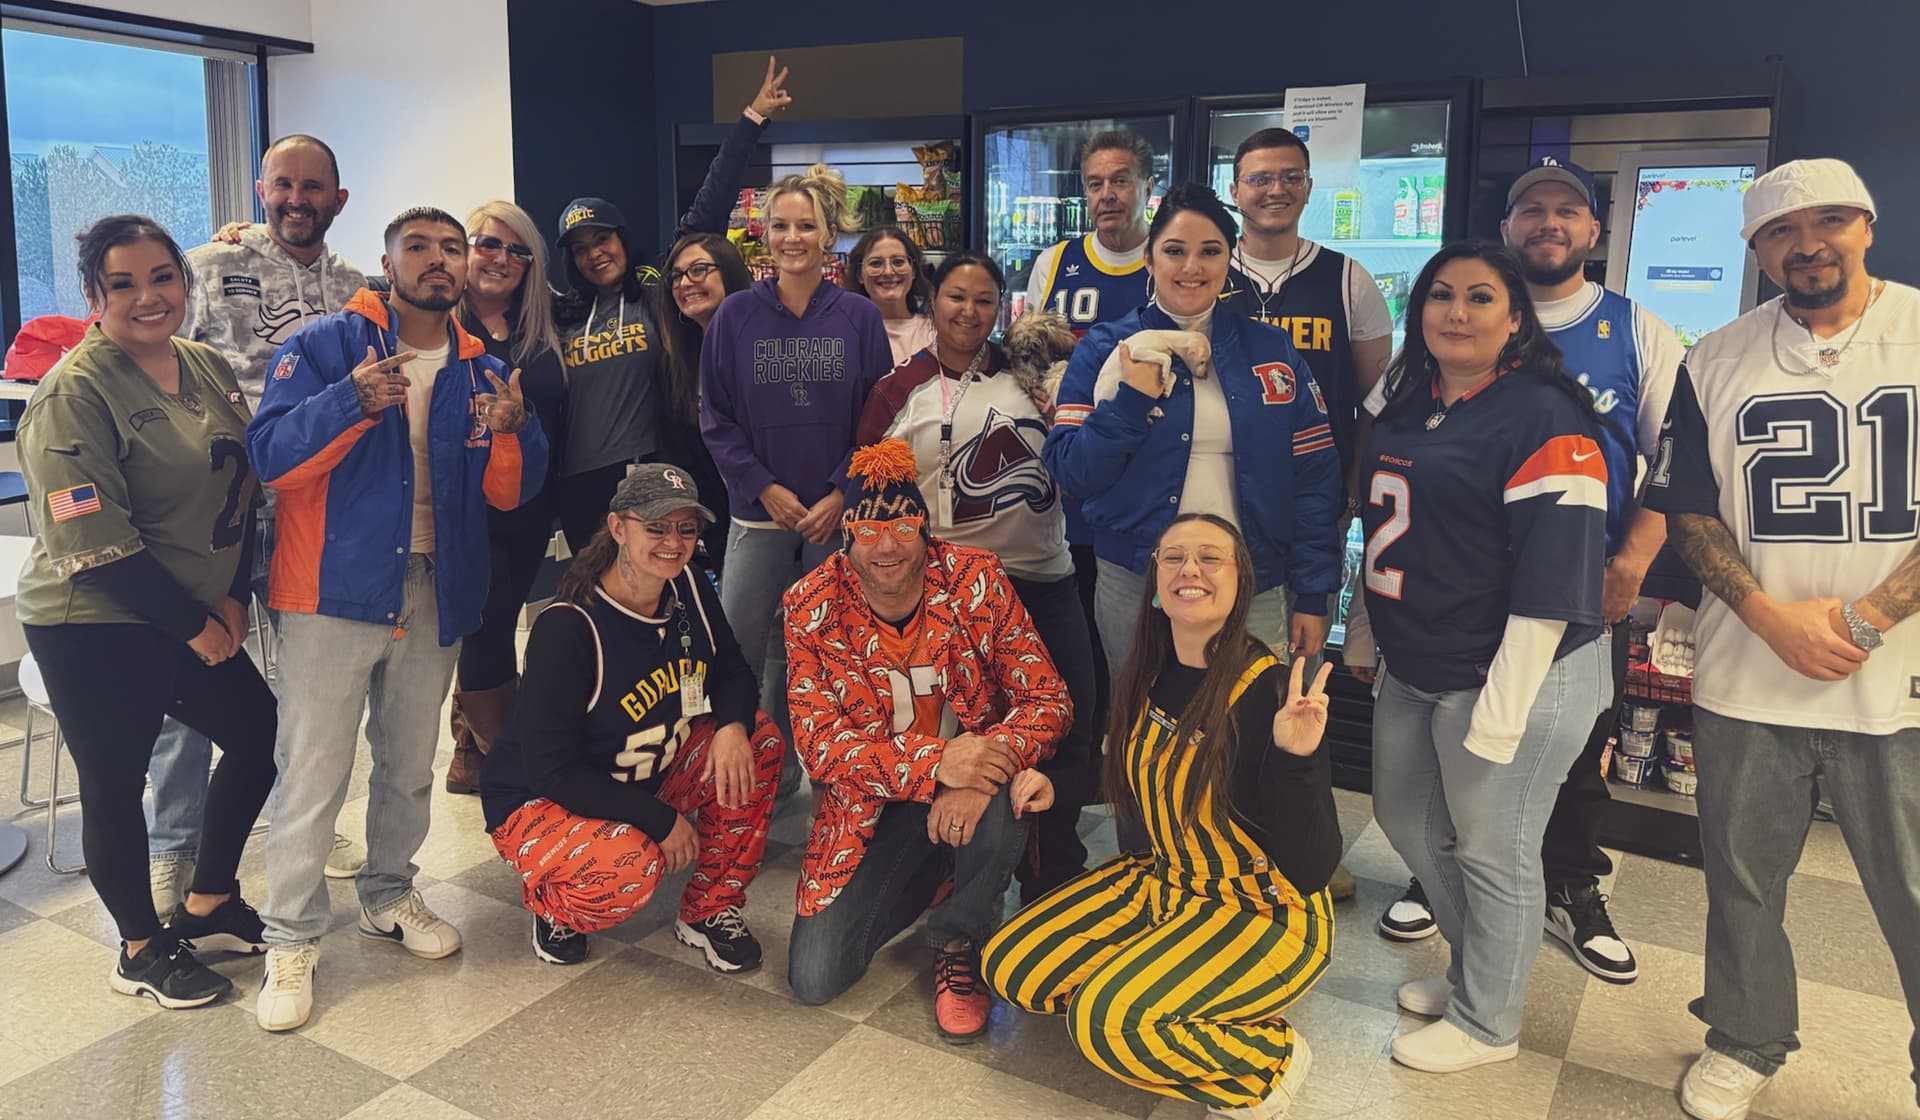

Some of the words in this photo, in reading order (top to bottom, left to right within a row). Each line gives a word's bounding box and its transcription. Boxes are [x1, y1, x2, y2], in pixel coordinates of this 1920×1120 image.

[1055, 287, 1100, 323] 10
[568, 323, 646, 351] ENVER
[754, 337, 845, 361] COLORADO
[754, 358, 846, 385] ROCKIES
[1736, 385, 1920, 543] 21
[1365, 470, 1412, 601] 2
[819, 864, 857, 881] BRONC
